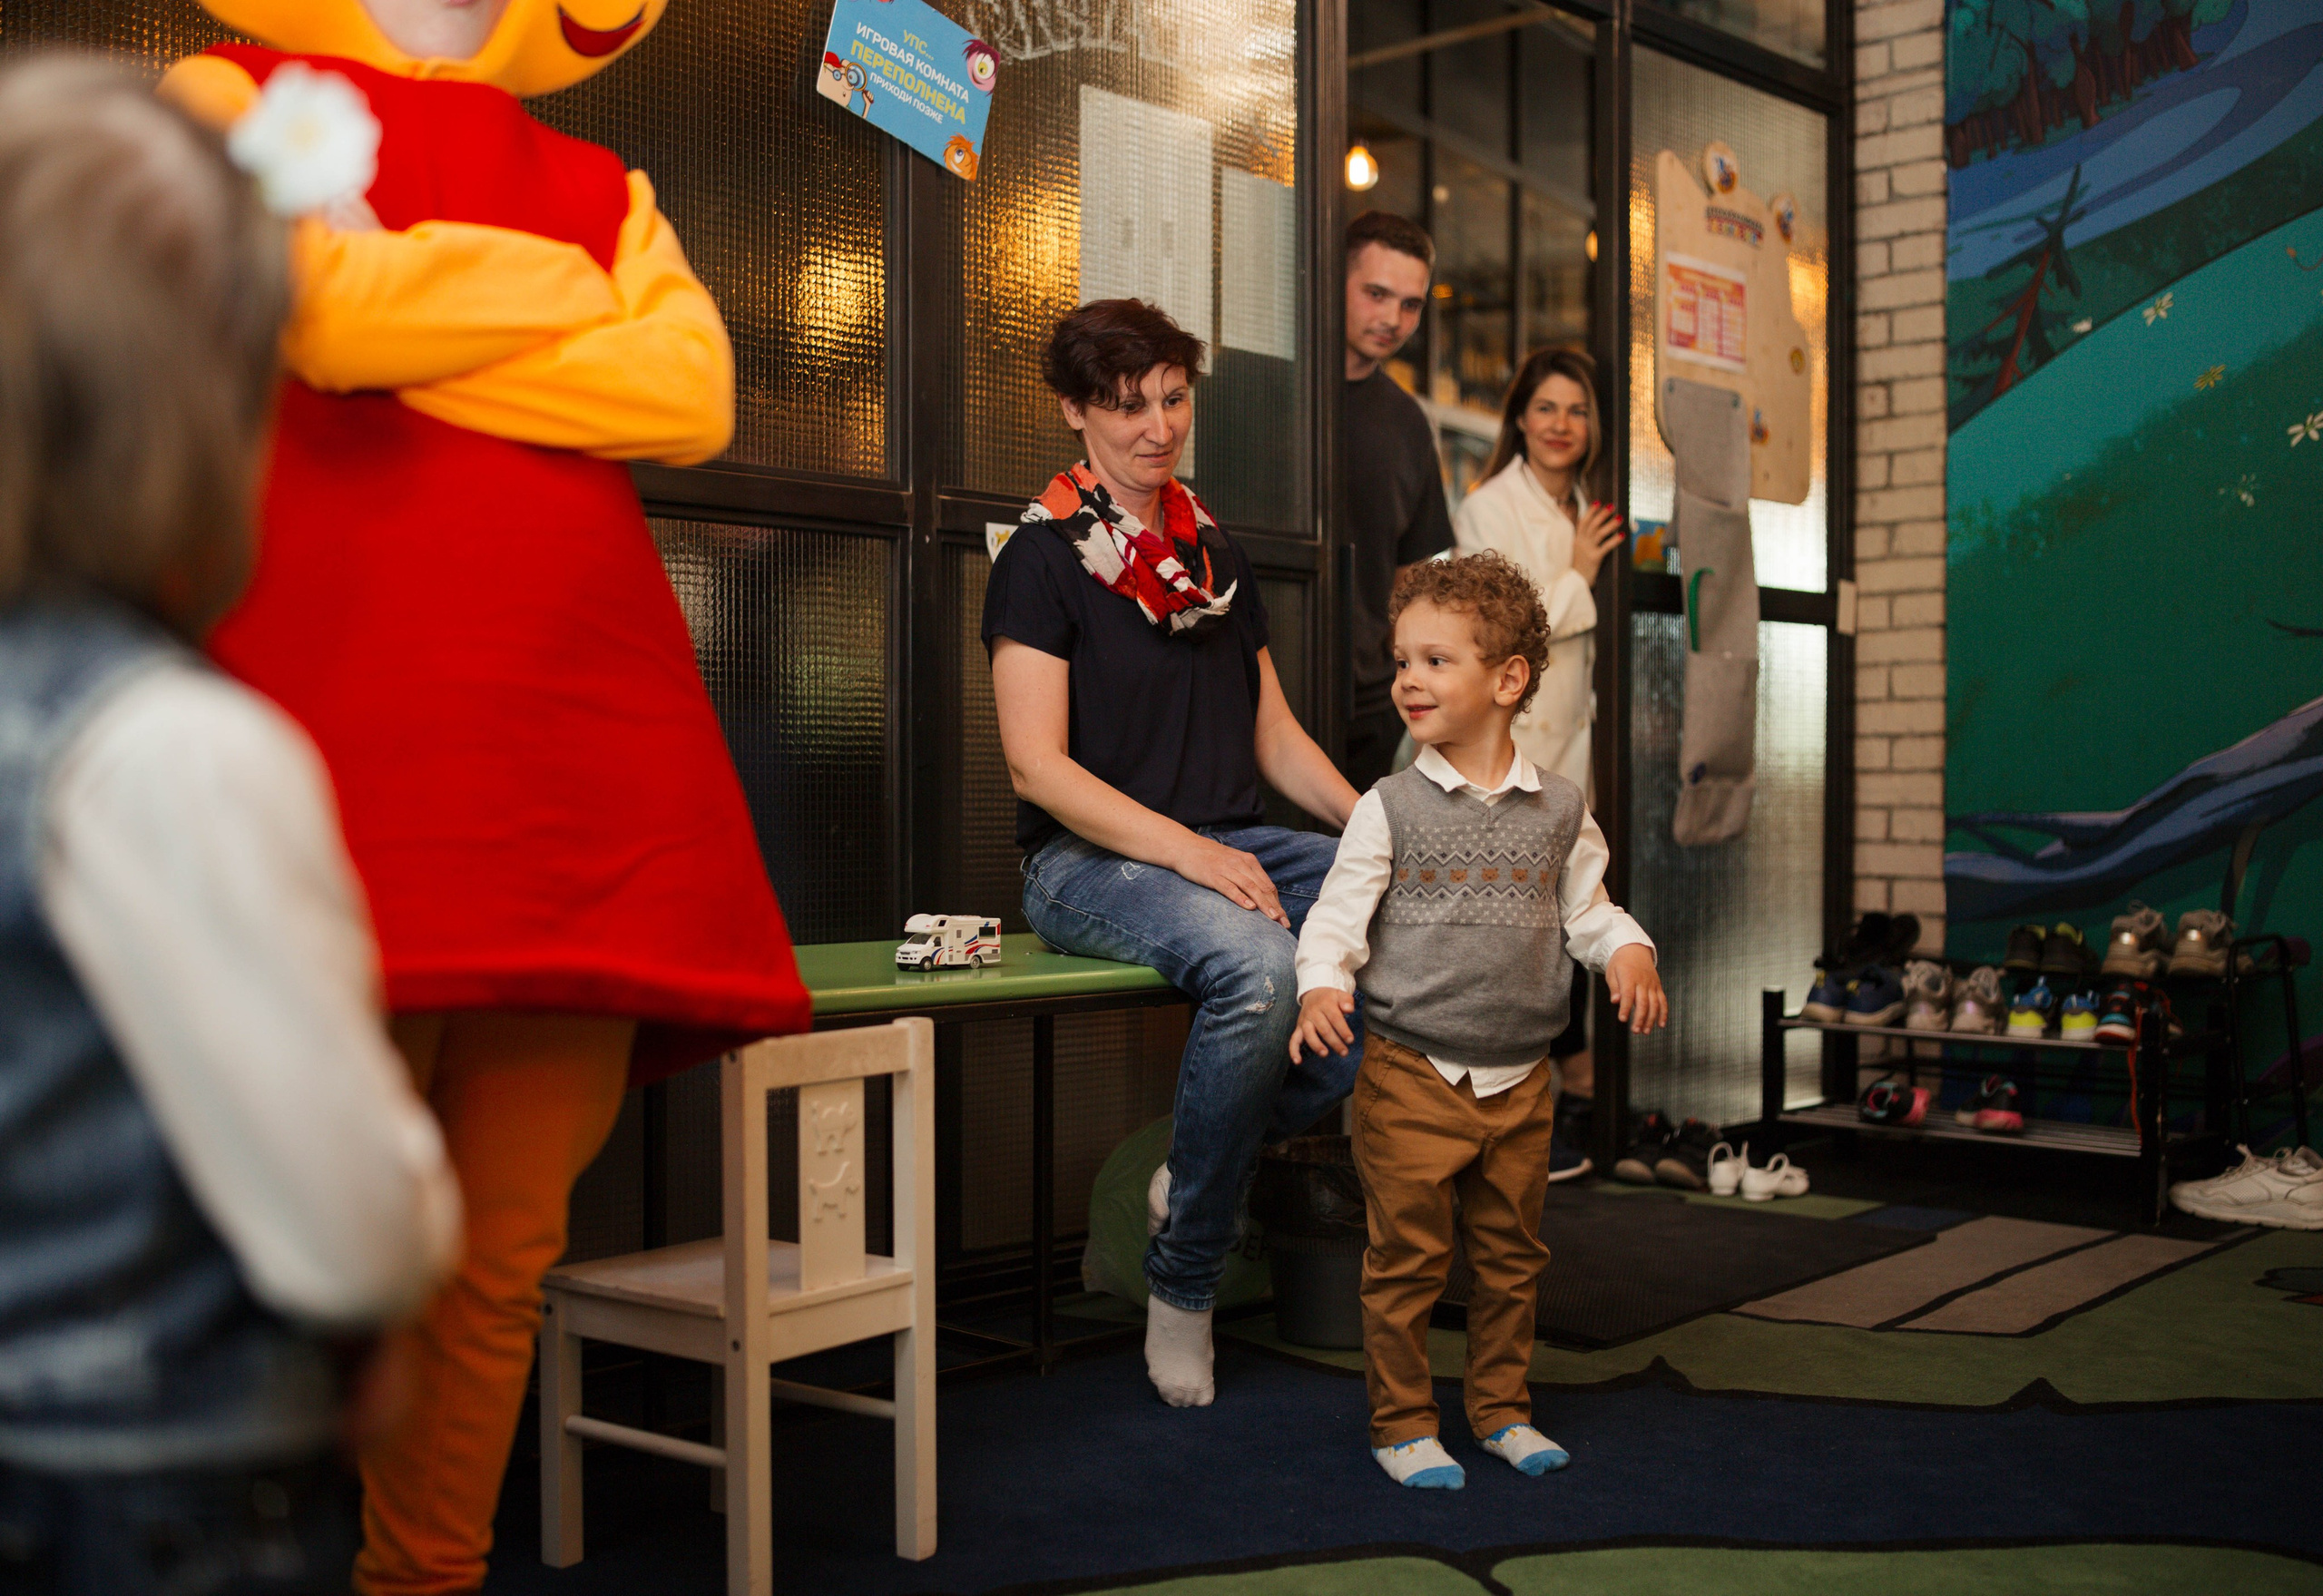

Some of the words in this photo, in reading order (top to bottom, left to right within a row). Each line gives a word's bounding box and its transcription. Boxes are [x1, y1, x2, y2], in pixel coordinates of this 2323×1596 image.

[856, 22, 914, 66] ИГРОВАЯ
[916, 61, 969, 103] КОМНАТА
[903, 30, 934, 61] УПС...
[850, 40, 965, 124] ПЕРЕПОЛНЕНА
[869, 72, 912, 105] ПРИХОДИ
[912, 98, 944, 123] ПОЗЖЕ
